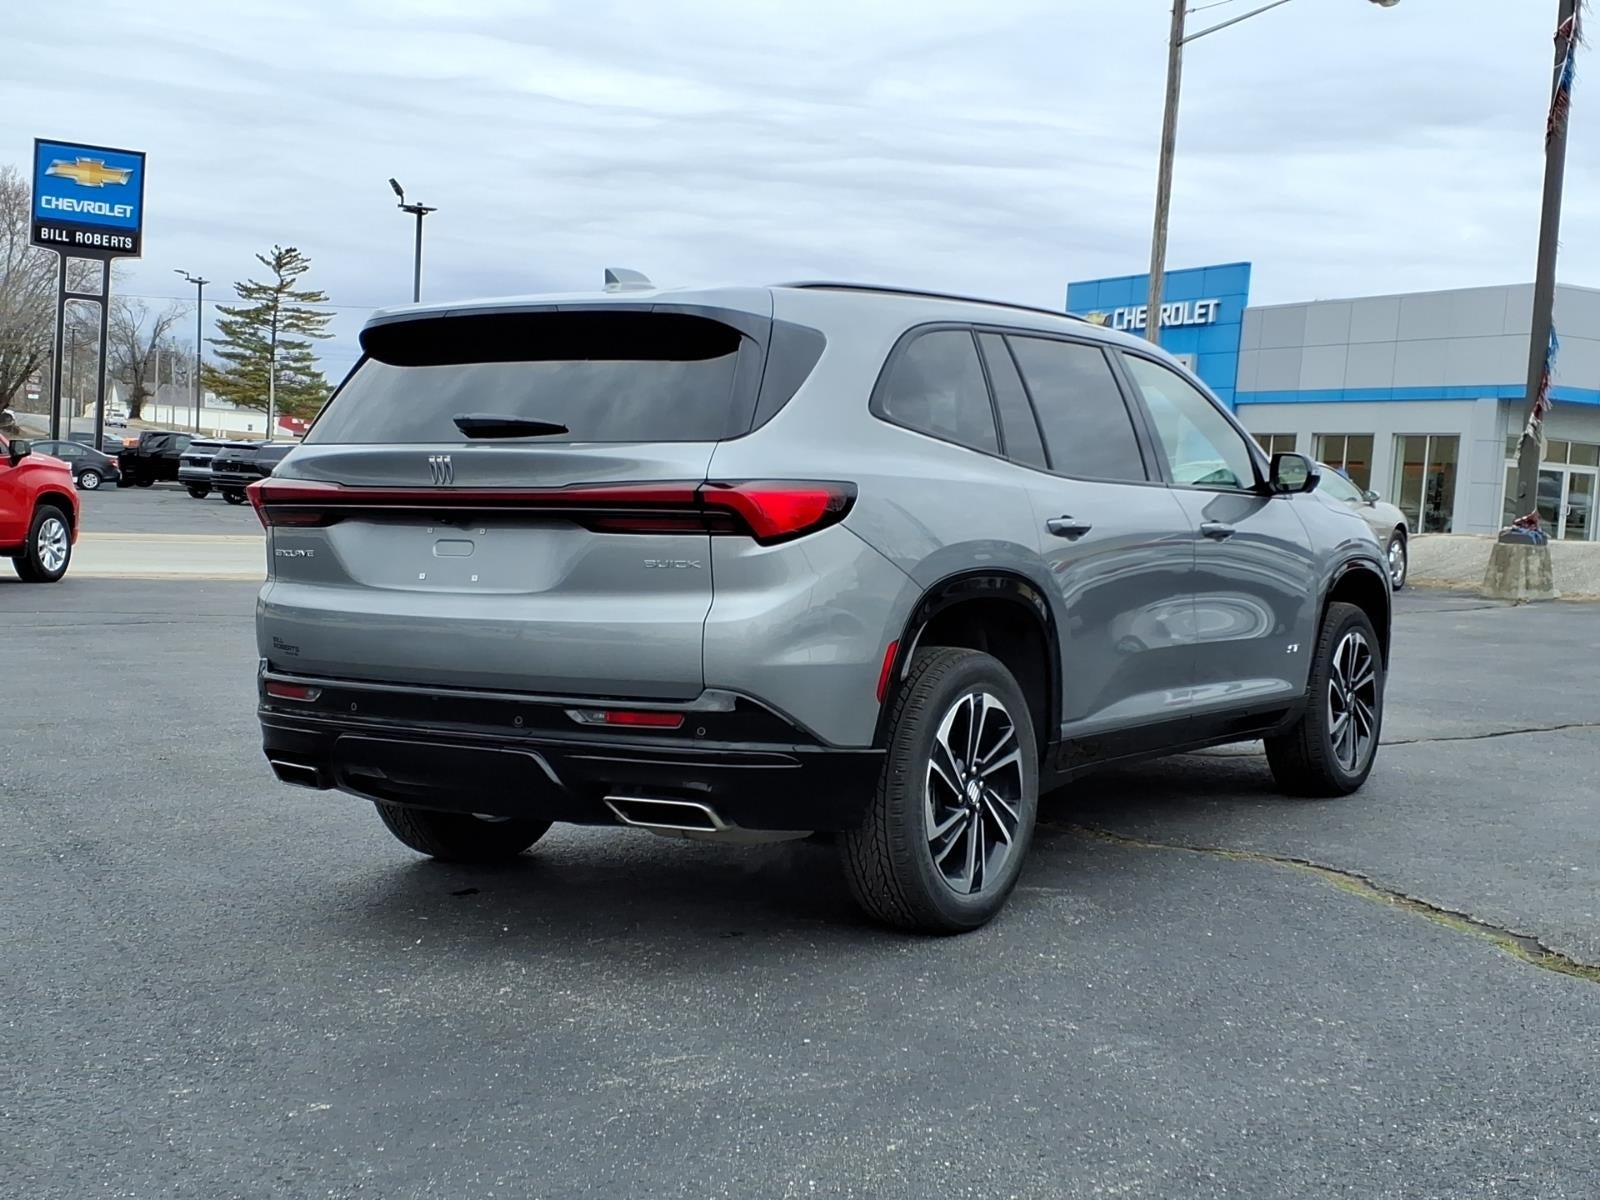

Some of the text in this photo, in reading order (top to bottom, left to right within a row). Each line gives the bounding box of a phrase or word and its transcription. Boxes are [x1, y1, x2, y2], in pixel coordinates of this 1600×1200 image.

[41, 195, 134, 218] CHEVROLET
[41, 227, 133, 249] BILL ROBERTS
[1112, 299, 1219, 330] CHEROLET
[642, 559, 702, 568] BUICK
